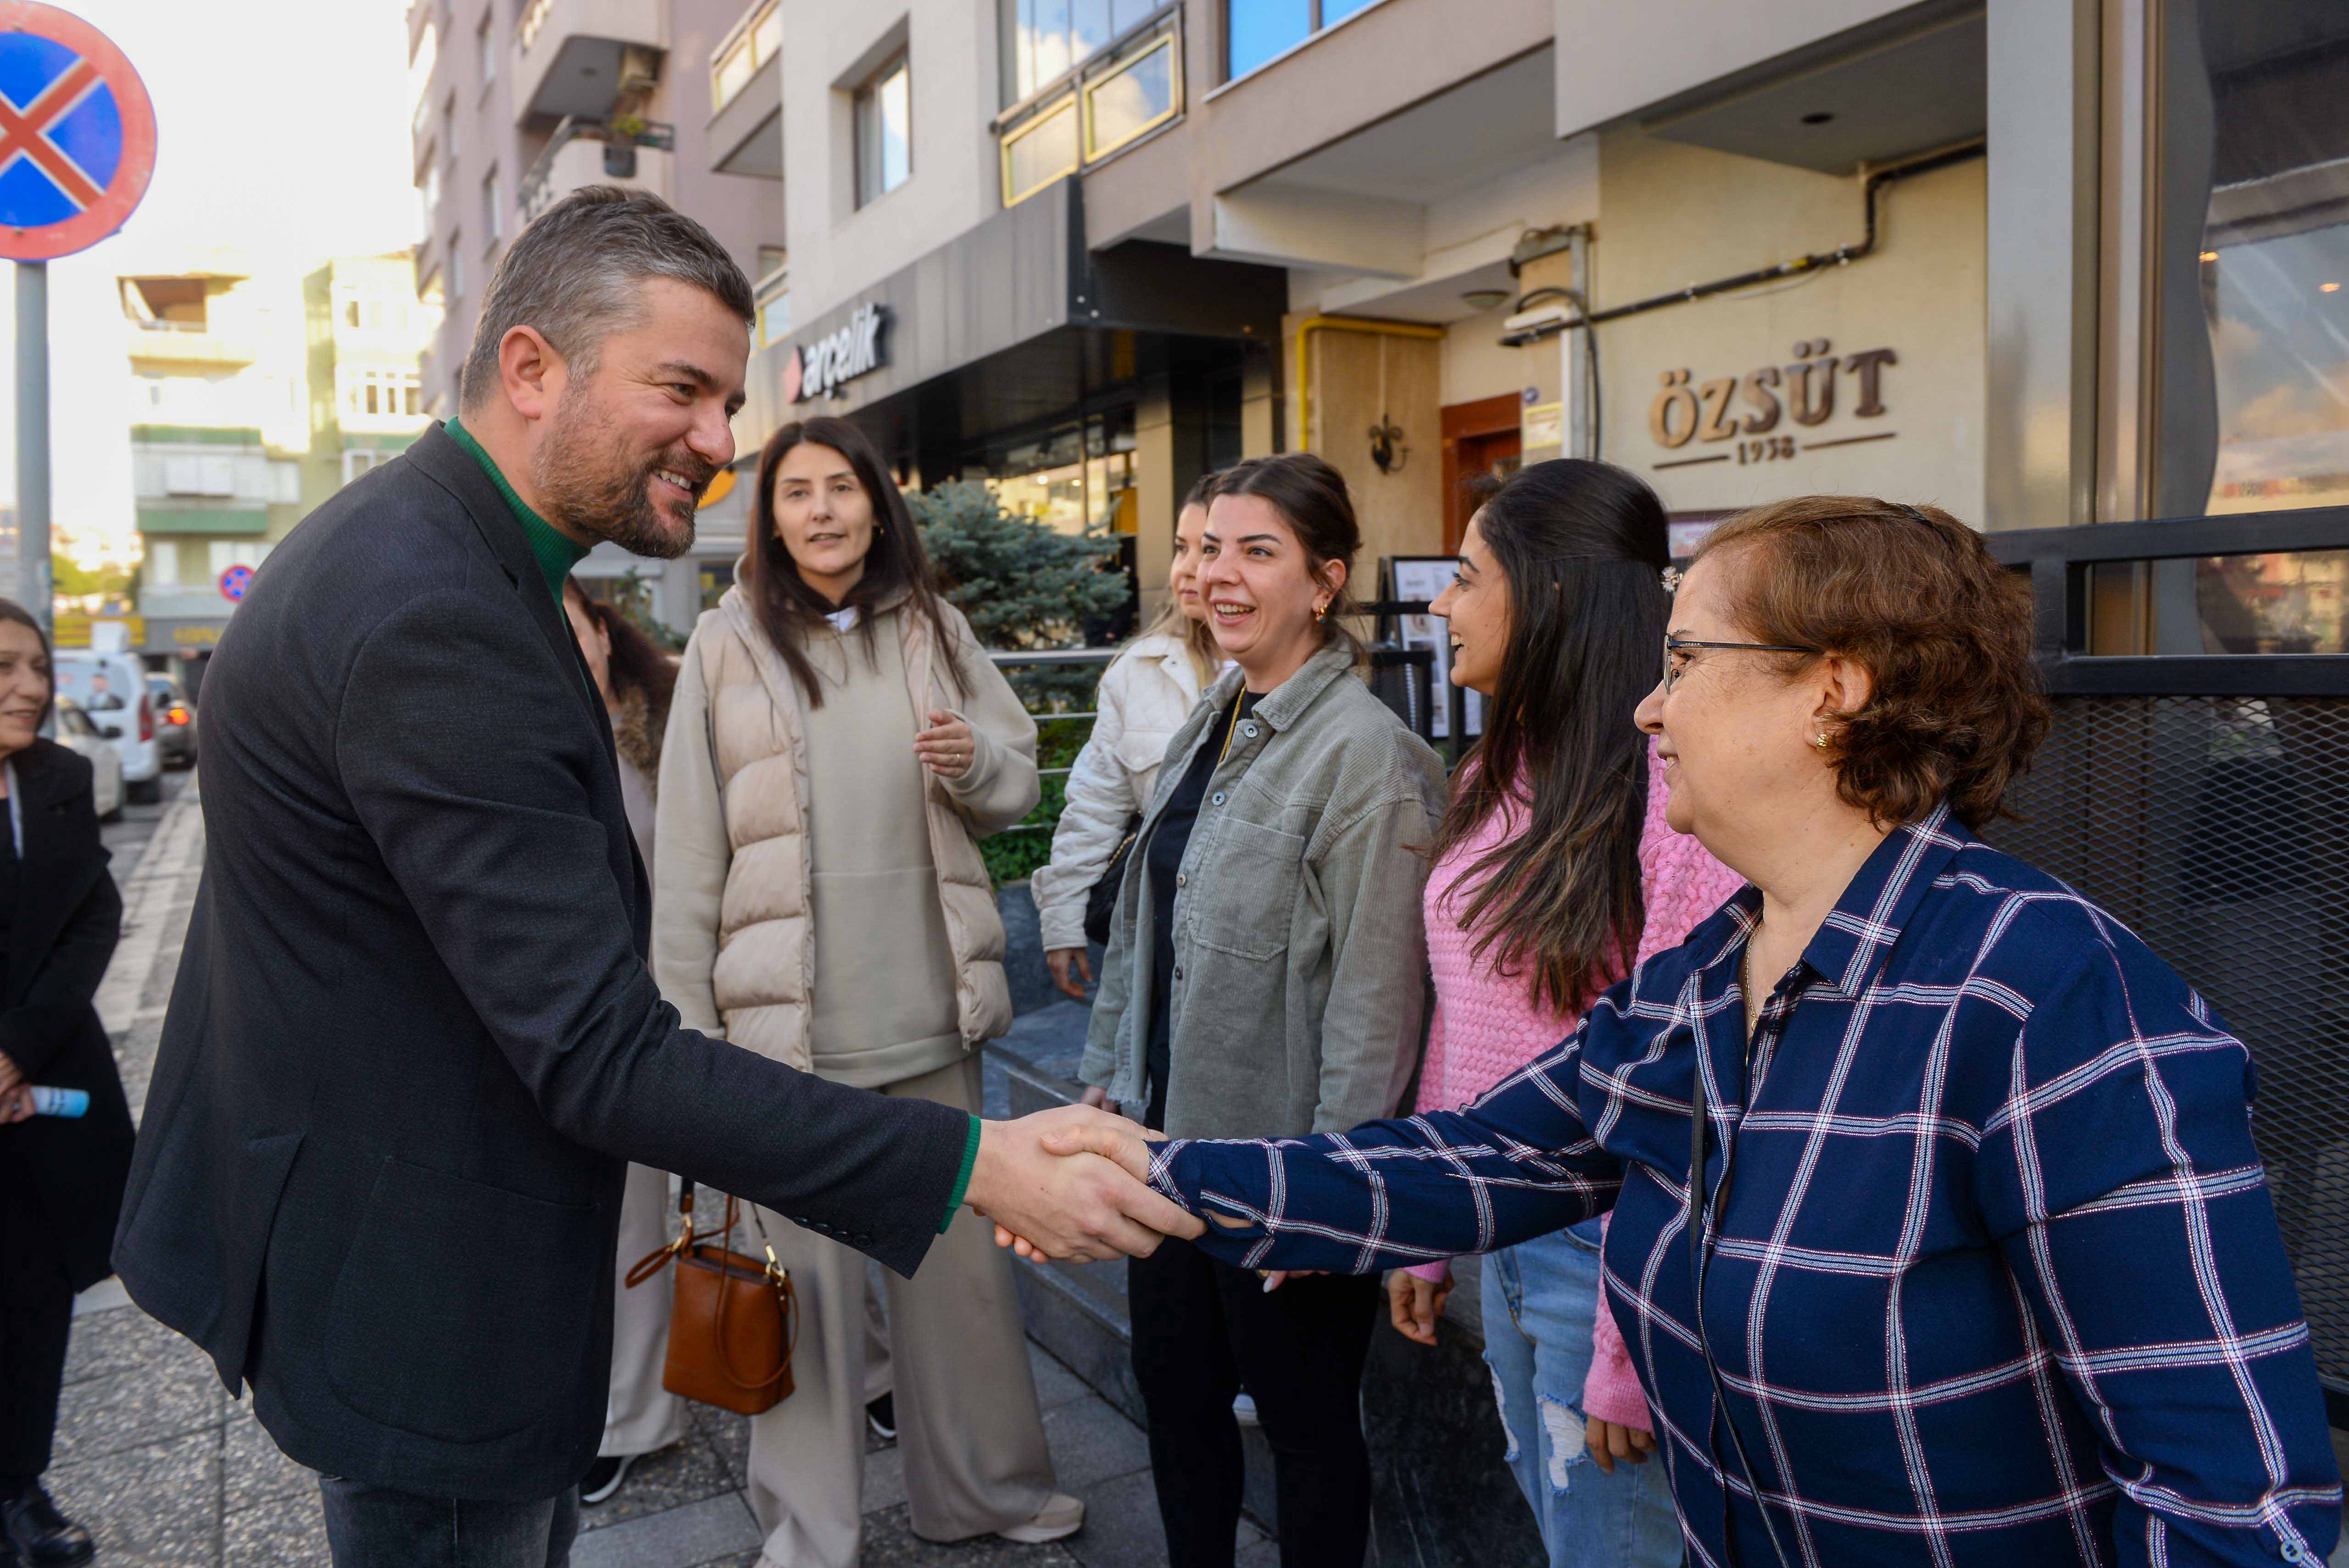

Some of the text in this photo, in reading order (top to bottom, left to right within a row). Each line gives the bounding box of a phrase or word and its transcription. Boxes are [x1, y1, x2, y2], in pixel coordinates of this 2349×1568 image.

[802, 302, 880, 400] arçelik
[1649, 338, 1898, 449] ÖZSÜT
[1737, 435, 1797, 465] 1938
